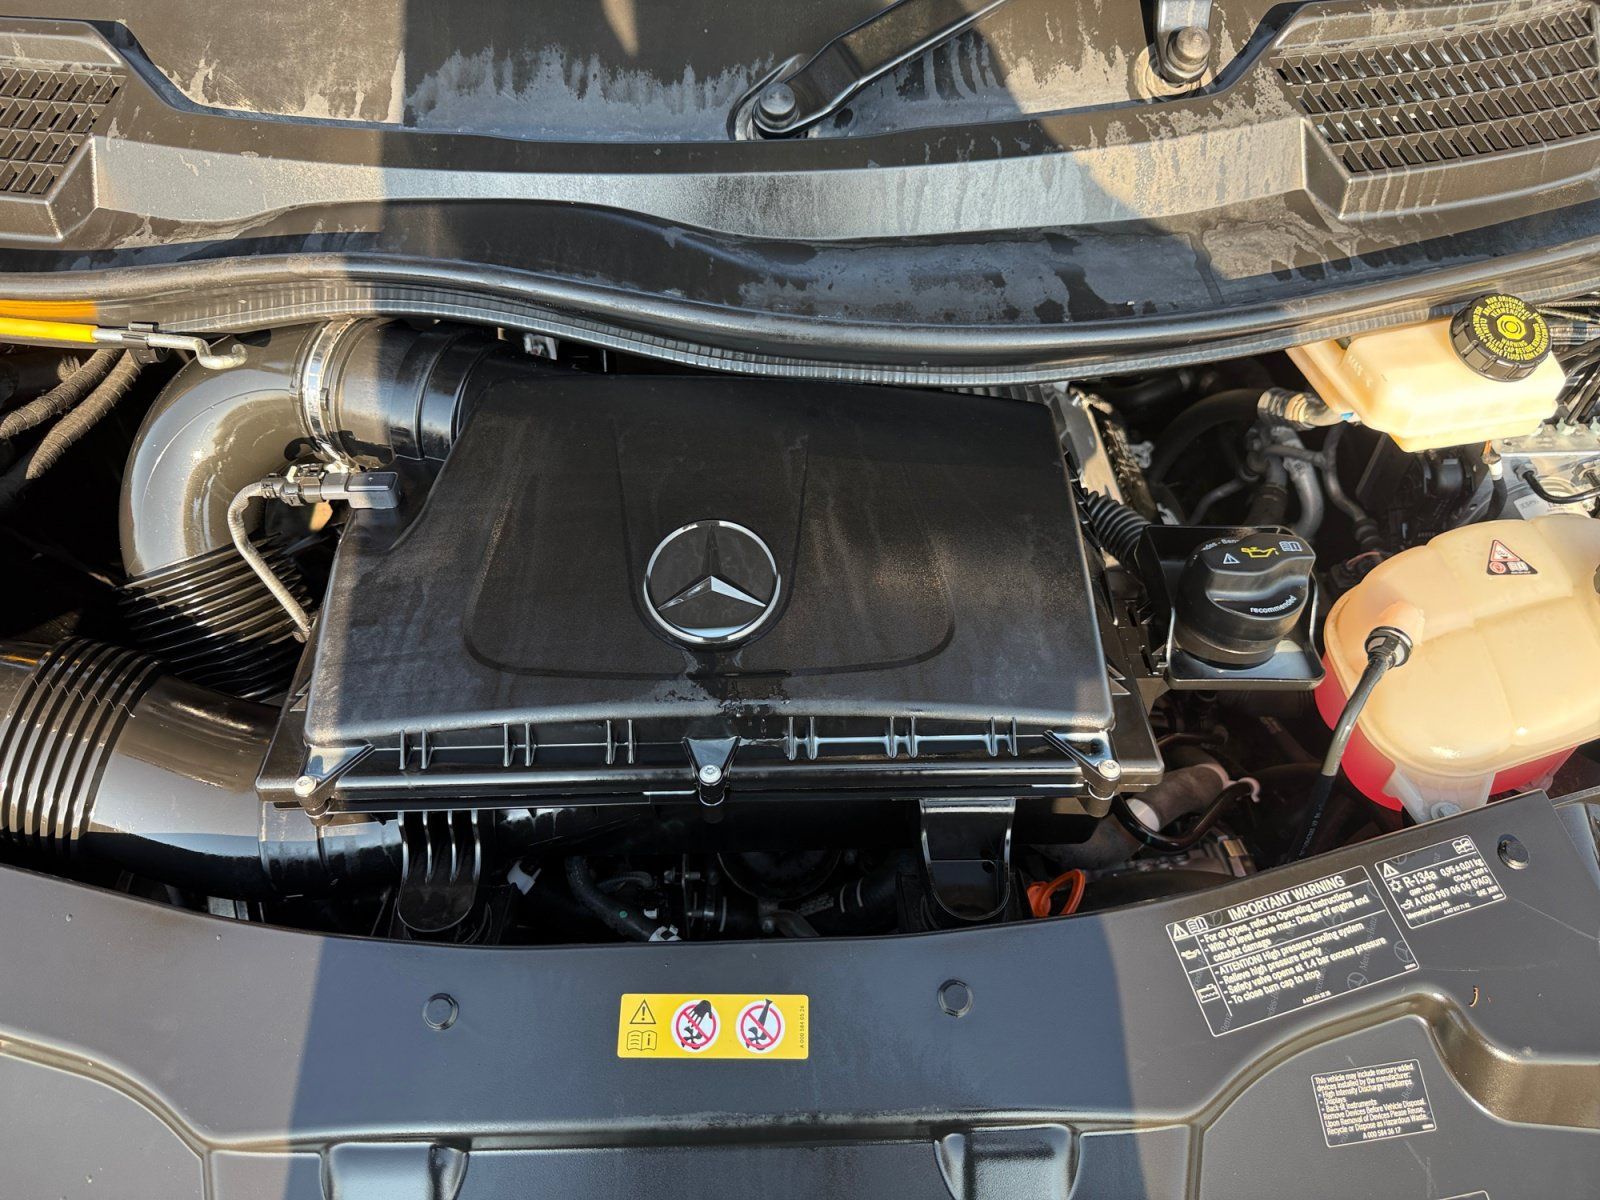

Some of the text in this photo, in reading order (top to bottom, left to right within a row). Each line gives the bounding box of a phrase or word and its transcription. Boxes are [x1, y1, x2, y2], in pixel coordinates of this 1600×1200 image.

[1250, 595, 1297, 613] recommended
[1403, 871, 1437, 887] R-134a
[1415, 876, 1491, 906] A 000 989 06 06 (PAG)
[1229, 876, 1344, 920] IMPORTANT WARNING
[1204, 934, 1217, 942] For
[1218, 929, 1228, 938] oil
[1227, 925, 1250, 936] types,
[1250, 918, 1267, 928] refer
[1277, 904, 1312, 920] Operating
[1208, 941, 1226, 952] With
[1227, 937, 1236, 946] oil
[1236, 932, 1254, 943] level
[1254, 927, 1276, 938] above
[1296, 912, 1322, 924] Danger
[1323, 907, 1331, 916] of
[1331, 901, 1355, 913] engine
[1355, 895, 1369, 905] and
[1214, 939, 1271, 961] catalyst damage
[1220, 923, 1364, 974] ATTENTION! High pressure cooling system
[1223, 947, 1322, 984] Relieve high pressure slowly
[1228, 938, 1386, 995] Safety valve opens at 1.4 bar excess pressure
[1231, 995, 1243, 1003] To
[1243, 989, 1263, 1000] close
[1263, 984, 1280, 993] turn
[1280, 979, 1294, 988] cap
[1304, 970, 1320, 980] stop
